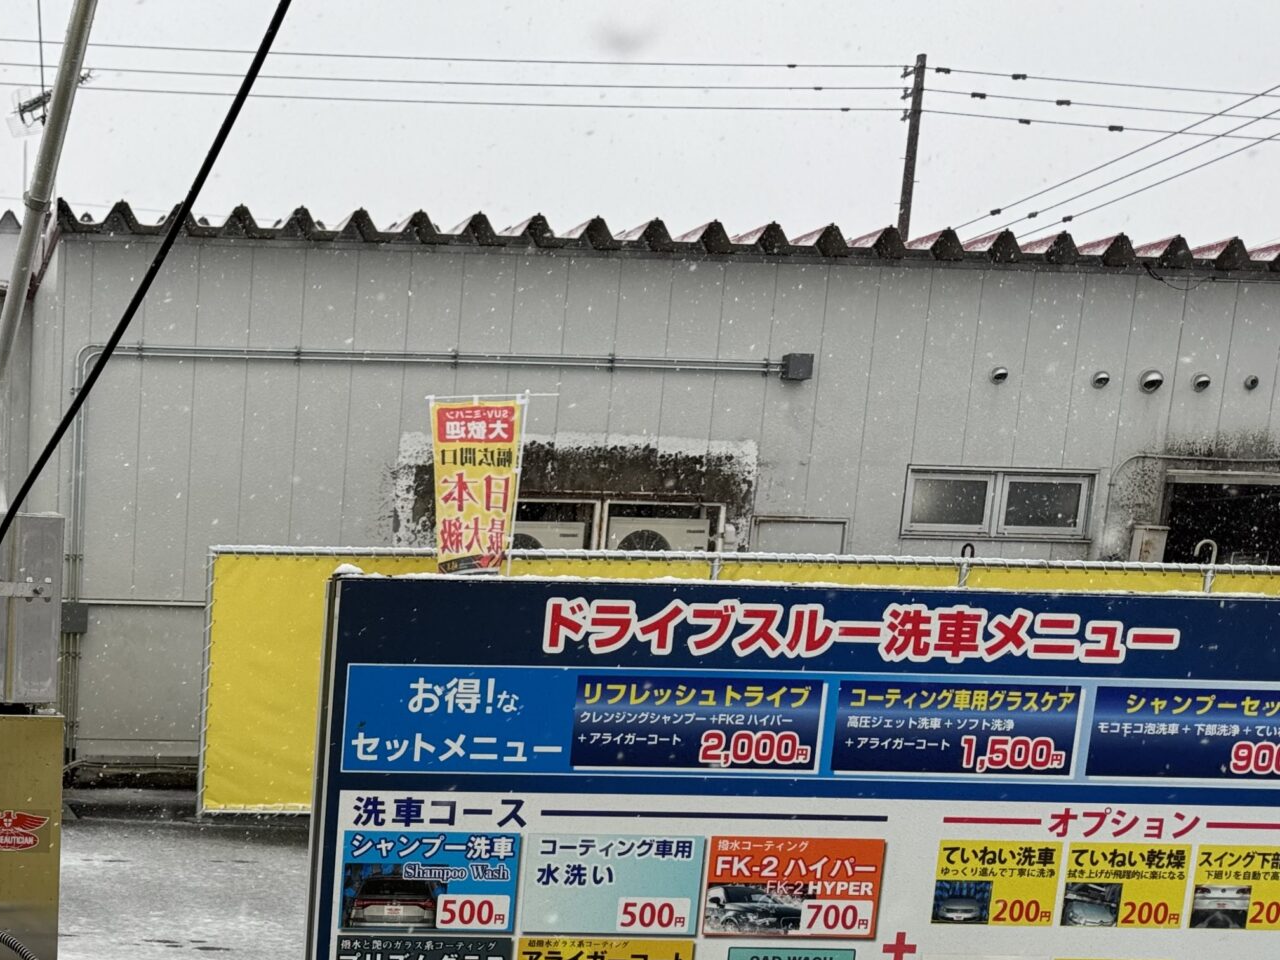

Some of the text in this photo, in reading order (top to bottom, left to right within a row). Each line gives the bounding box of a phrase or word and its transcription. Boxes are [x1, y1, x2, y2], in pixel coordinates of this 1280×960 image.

[544, 597, 1179, 664] ドライブスルー洗車メニュー
[850, 688, 1075, 712] コーティング車用グラスケア
[847, 715, 941, 730] 高圧ジェット洗車
[956, 719, 1015, 731] ソフト洗浄
[1098, 722, 1179, 735] モコモコ泡洗車
[1194, 724, 1240, 736] 下部洗浄
[351, 732, 562, 762] セットメニュー
[589, 733, 682, 746] アライガーコート
[700, 731, 810, 765] 2,000円
[857, 737, 950, 750] アライガーコート
[961, 736, 1064, 771] 1,500円
[1231, 742, 1280, 774] 90
[352, 796, 527, 828] 洗車コース
[1048, 807, 1201, 840] オプション
[351, 834, 515, 860] シャンプー洗車
[540, 838, 693, 859] コーティング車用
[718, 839, 809, 852] 撥水コーティング
[943, 846, 1056, 867] ていねい洗車
[715, 855, 877, 879] FK-2 ハイパー
[1071, 848, 1186, 869] ていねい乾燥
[404, 863, 510, 881] Shampoo Wash
[536, 863, 614, 886] 水洗い
[940, 866, 1056, 878] ゆっくり進んで丁寧に洗浄
[1067, 868, 1186, 880] 拭き上げが飛躍的に楽になる
[766, 880, 874, 896] FK-2 HYPER
[440, 899, 505, 925] 500円
[621, 902, 685, 928] 500円
[807, 904, 869, 930] 700円
[992, 899, 1051, 922] 200円
[1121, 901, 1180, 924] 200円
